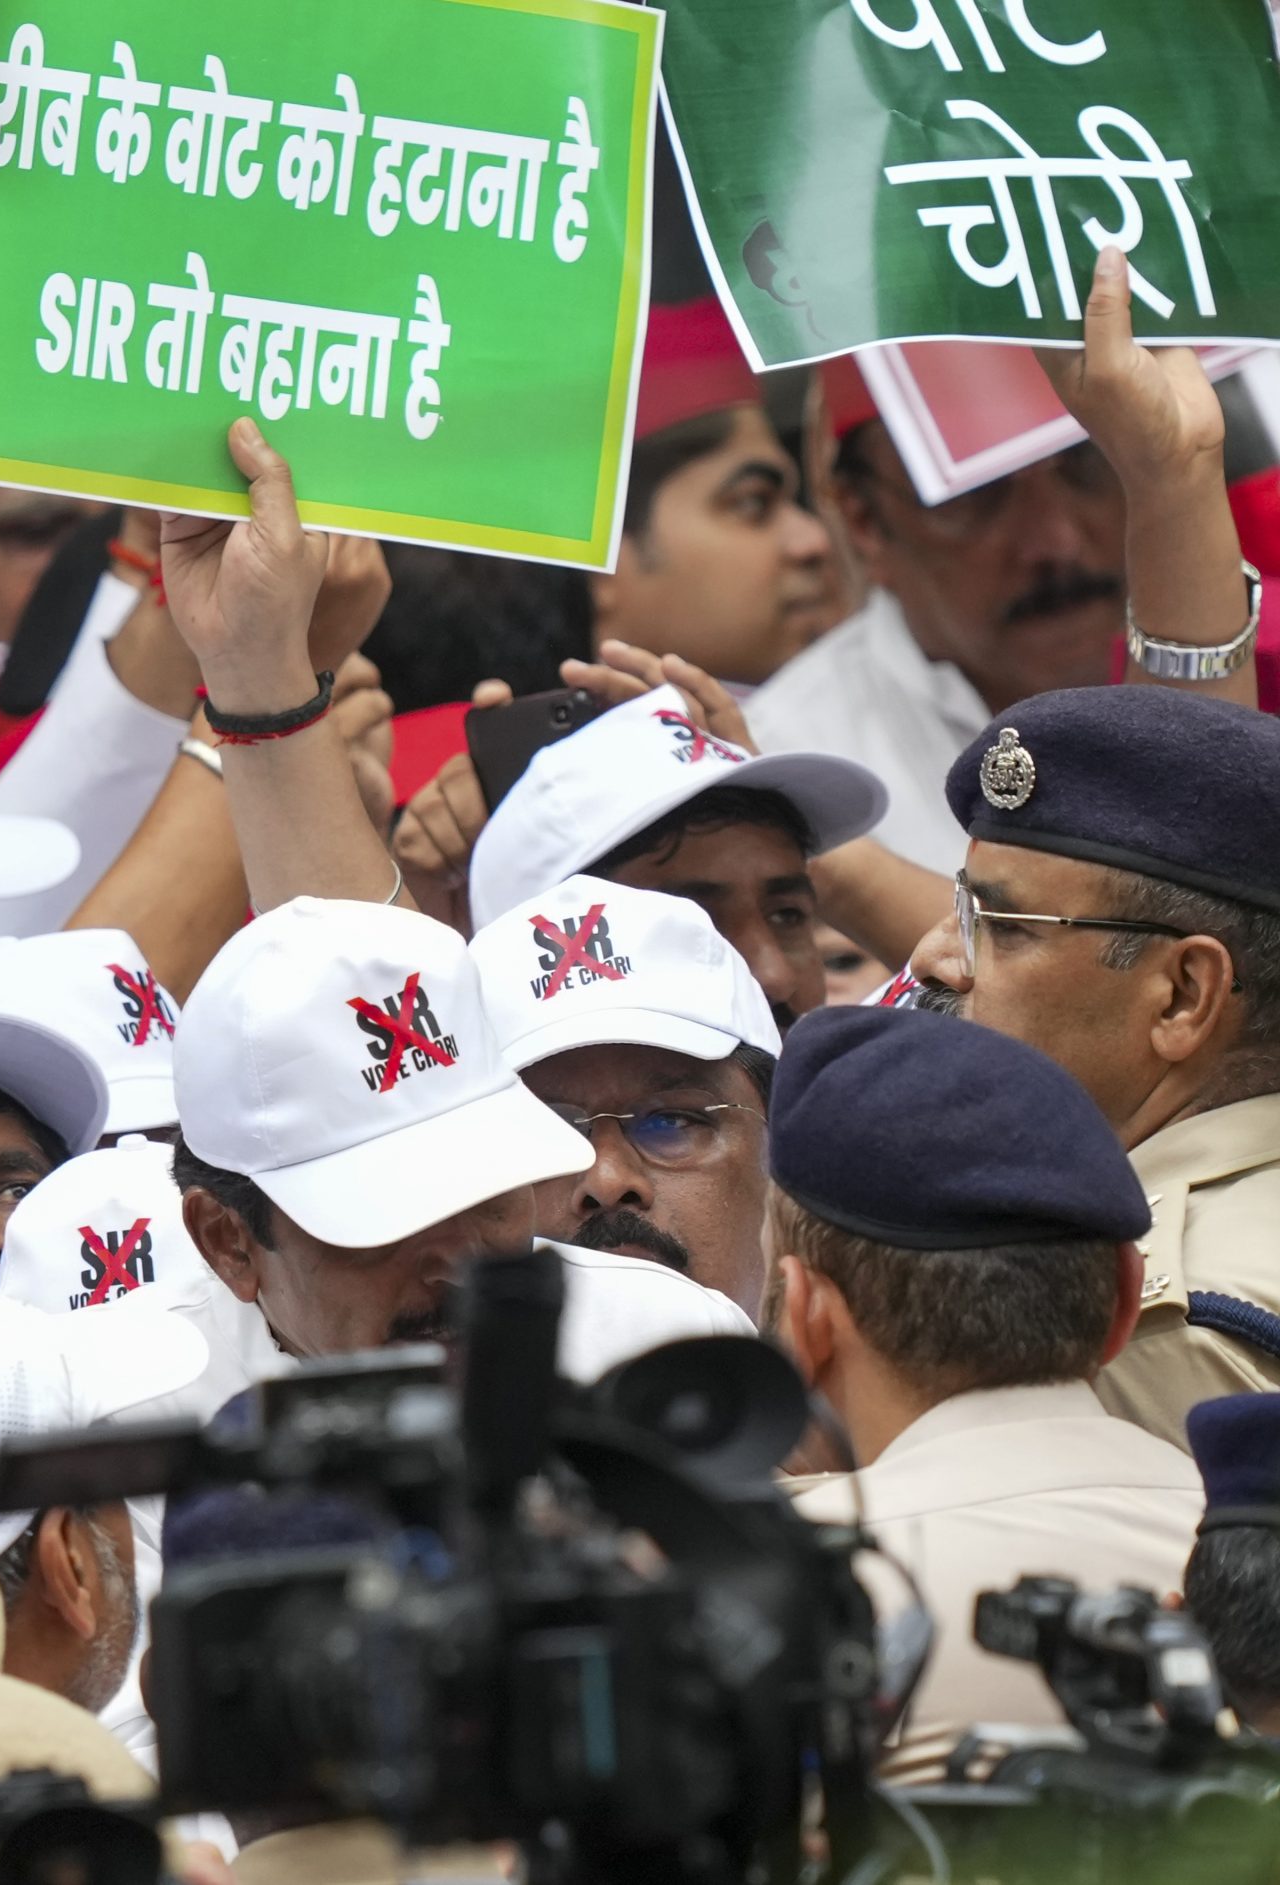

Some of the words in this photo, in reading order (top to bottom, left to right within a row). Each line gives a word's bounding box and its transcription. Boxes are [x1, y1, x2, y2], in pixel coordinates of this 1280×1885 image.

[96, 40, 162, 183] के
[165, 54, 274, 199] वोट
[277, 73, 366, 216] को
[367, 115, 550, 242] हटाना
[553, 96, 601, 263] है
[884, 99, 1217, 320] चोरी
[35, 272, 136, 383] SIR
[145, 251, 215, 394] तो
[219, 294, 401, 421] बहाना
[405, 274, 452, 440] है
[360, 1058, 411, 1092] VOE
[529, 969, 575, 999] VOE
